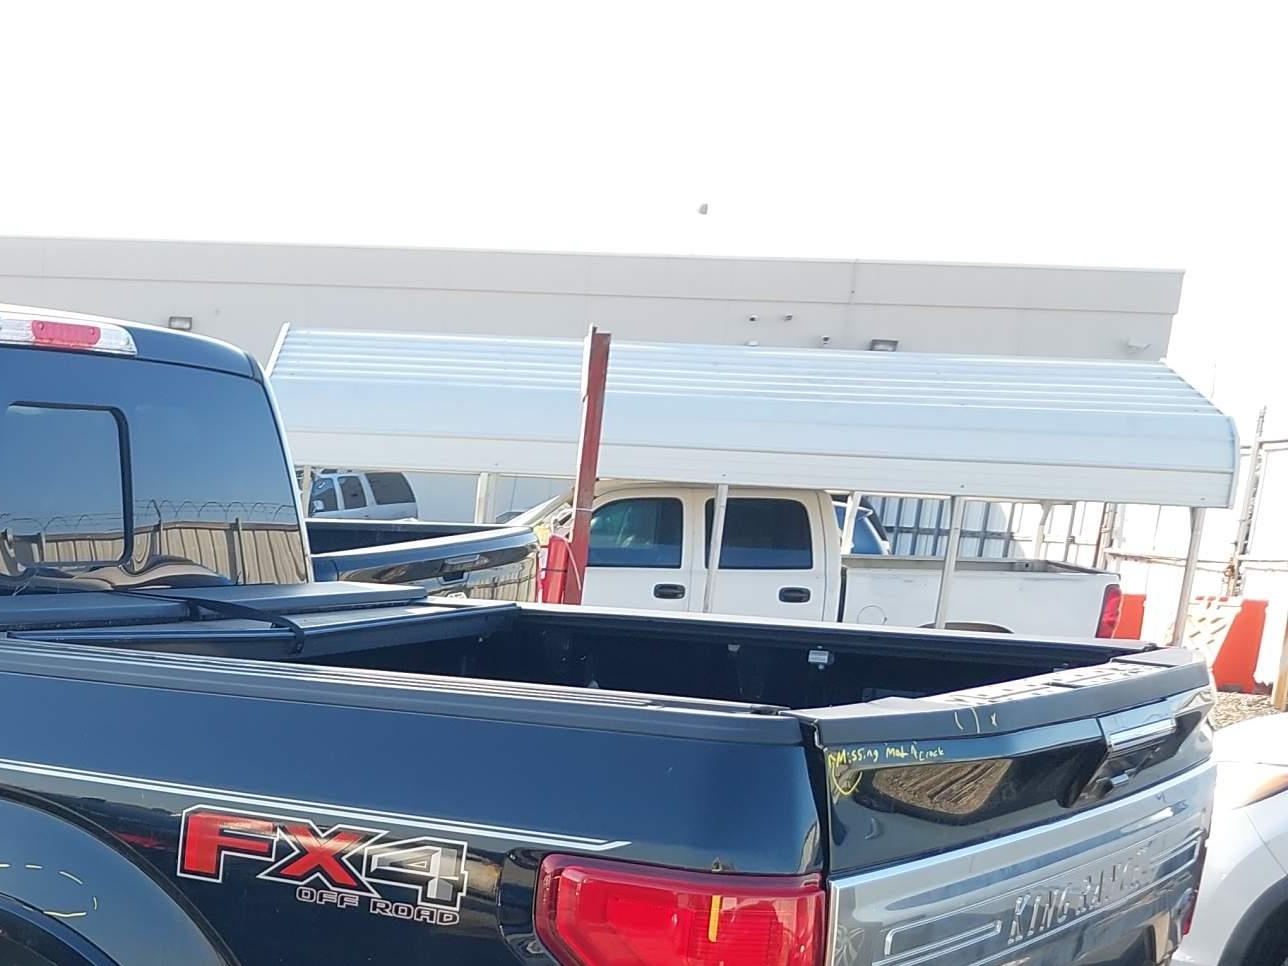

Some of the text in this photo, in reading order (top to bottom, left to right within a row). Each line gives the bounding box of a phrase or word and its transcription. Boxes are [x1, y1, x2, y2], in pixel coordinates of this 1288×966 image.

[176, 804, 468, 911] FX4
[296, 886, 460, 926] OFF ROAD
